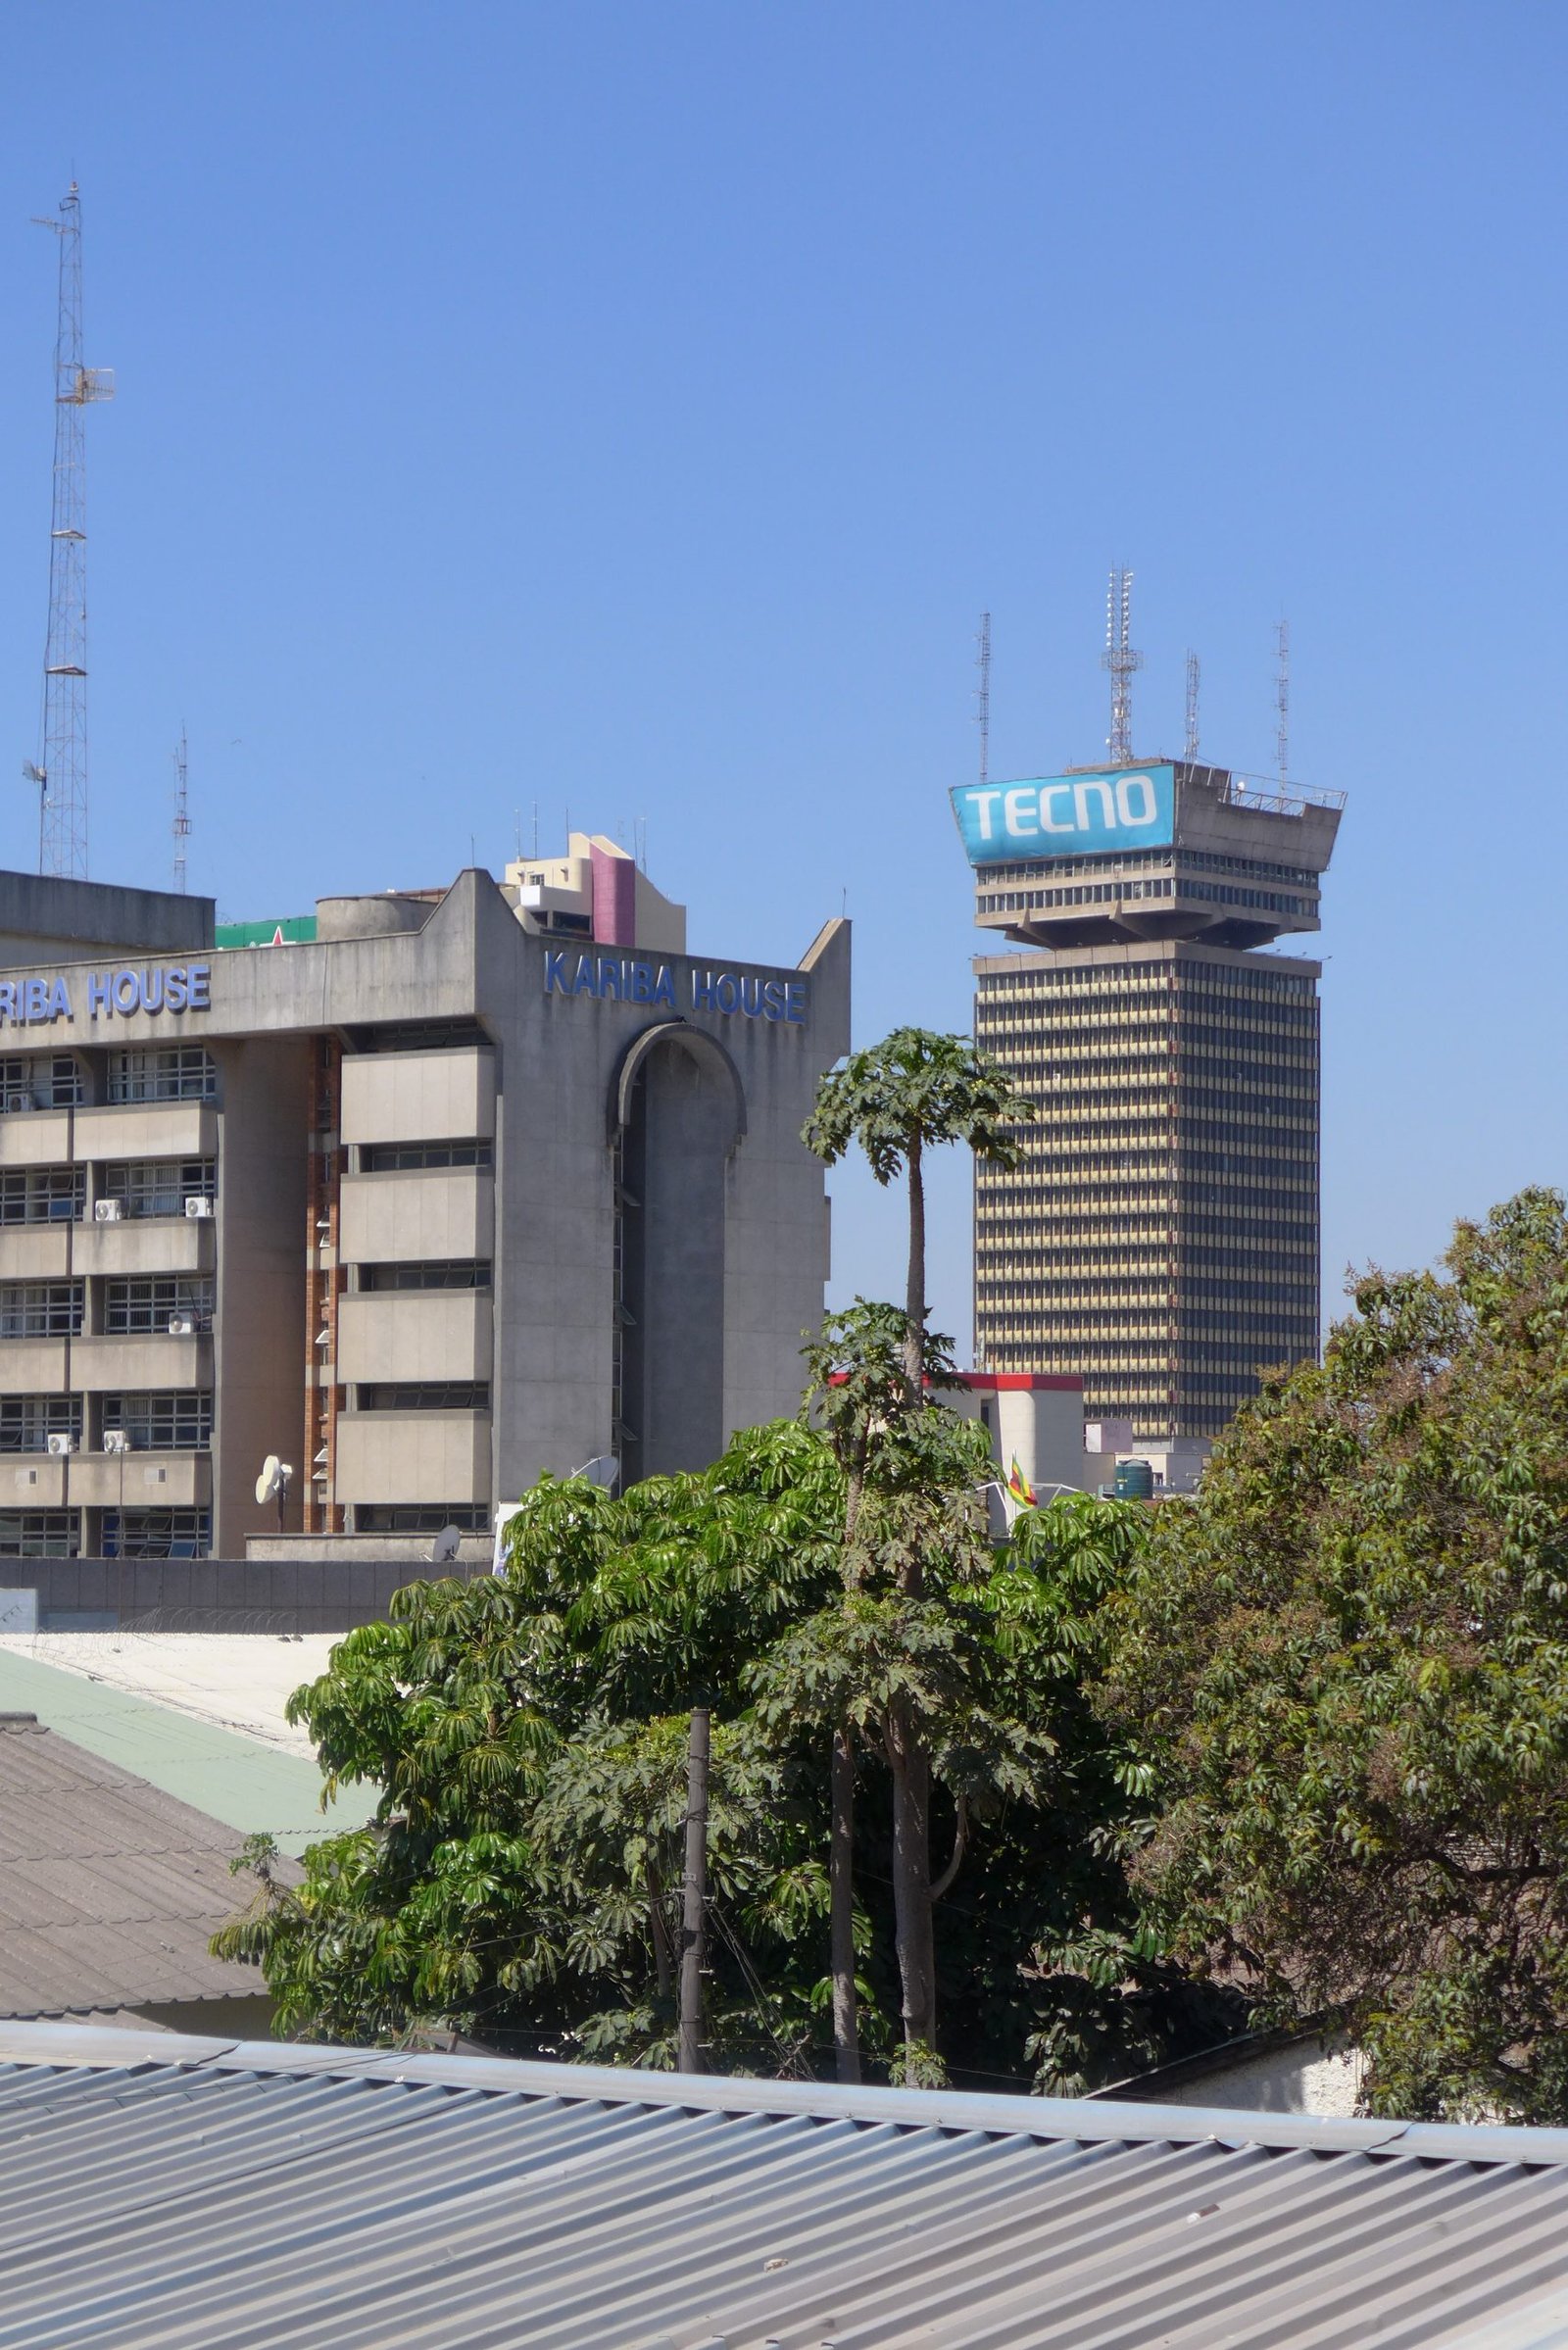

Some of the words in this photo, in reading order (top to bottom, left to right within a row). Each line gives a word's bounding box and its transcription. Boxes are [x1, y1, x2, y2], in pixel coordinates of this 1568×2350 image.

[965, 775, 1157, 840] TECNO
[87, 963, 212, 1014] HOUSE
[544, 950, 676, 1008] KARIBA
[692, 969, 807, 1025] HOUSE
